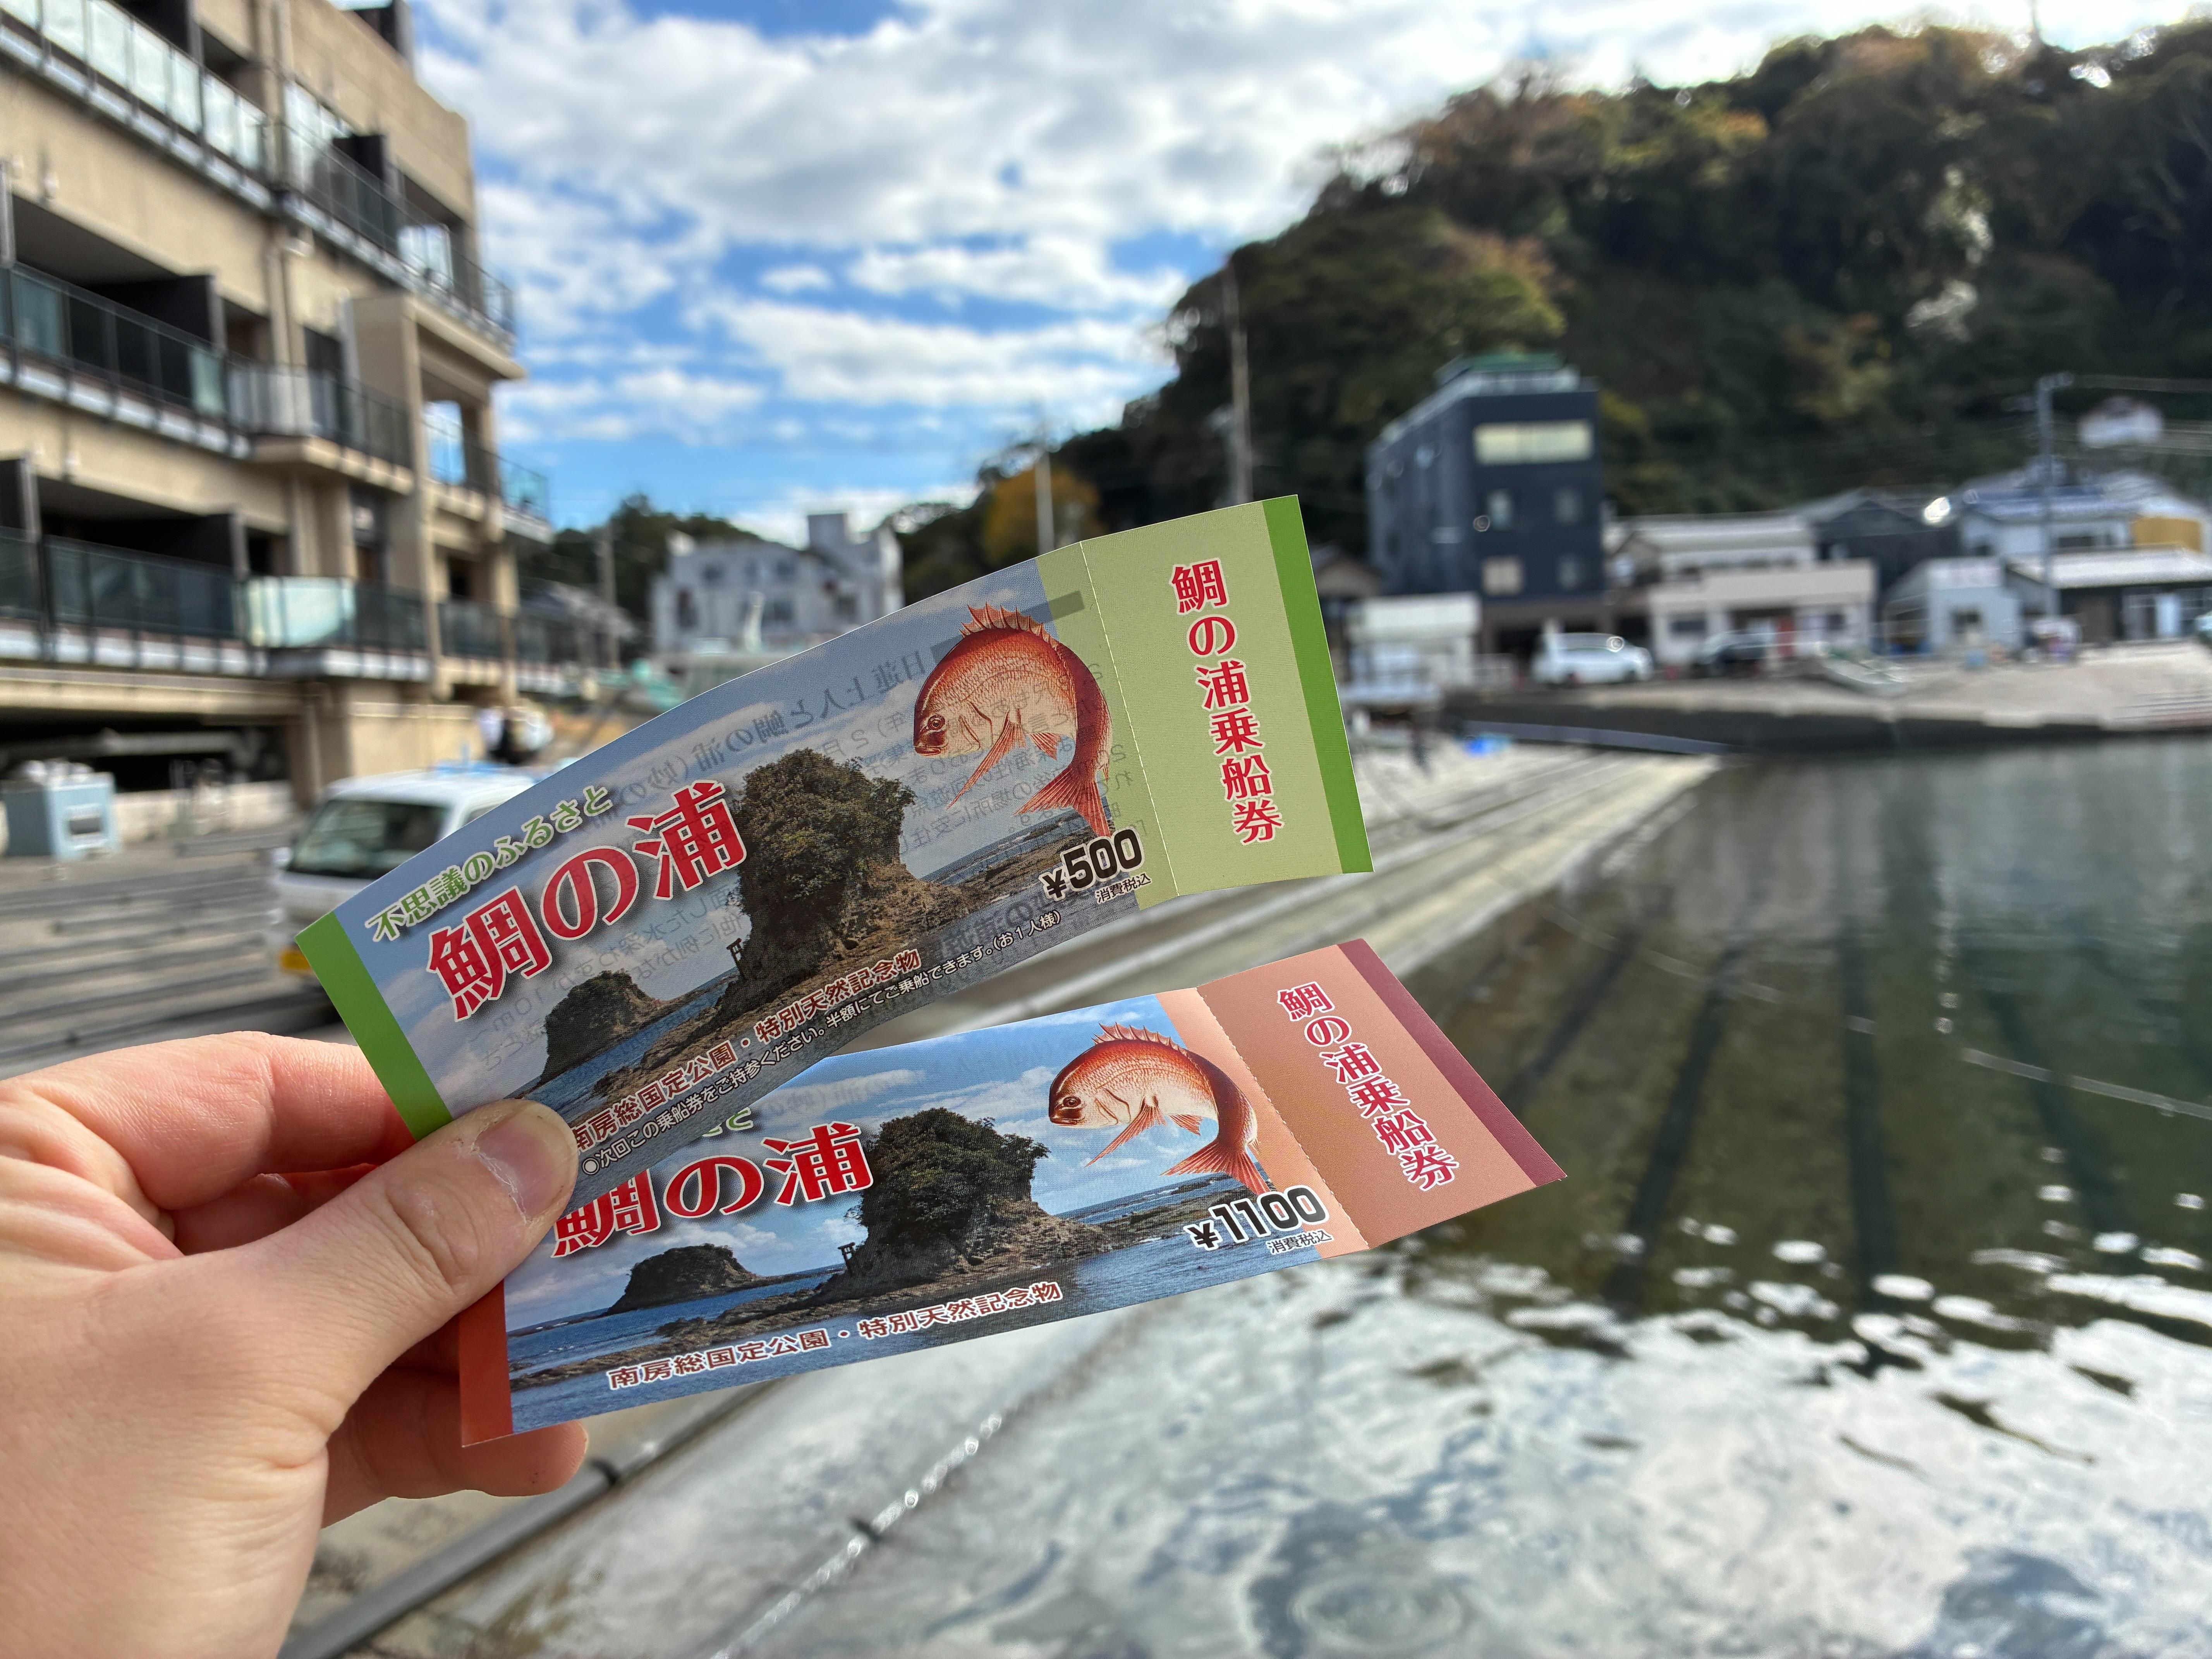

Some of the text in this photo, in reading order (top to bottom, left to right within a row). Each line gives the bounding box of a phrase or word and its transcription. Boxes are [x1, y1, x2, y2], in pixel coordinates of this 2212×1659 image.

[1170, 558, 1284, 845] 鯛の浦乗船券
[365, 785, 613, 942] 不思議のふるさと
[427, 780, 747, 1022] 鯛の浦
[1039, 827, 1144, 902] ¥500
[1094, 874, 1152, 905] 消費税込
[575, 949, 921, 1152] 南房総国定公園・特別天然記念物
[1276, 981, 1459, 1192] 鯛の浦乗船券
[1183, 1184, 1329, 1250] ¥1100
[1267, 1230, 1334, 1254] 消費税込
[606, 1281, 1062, 1390] 南房総国定公園・特別天然記念物
